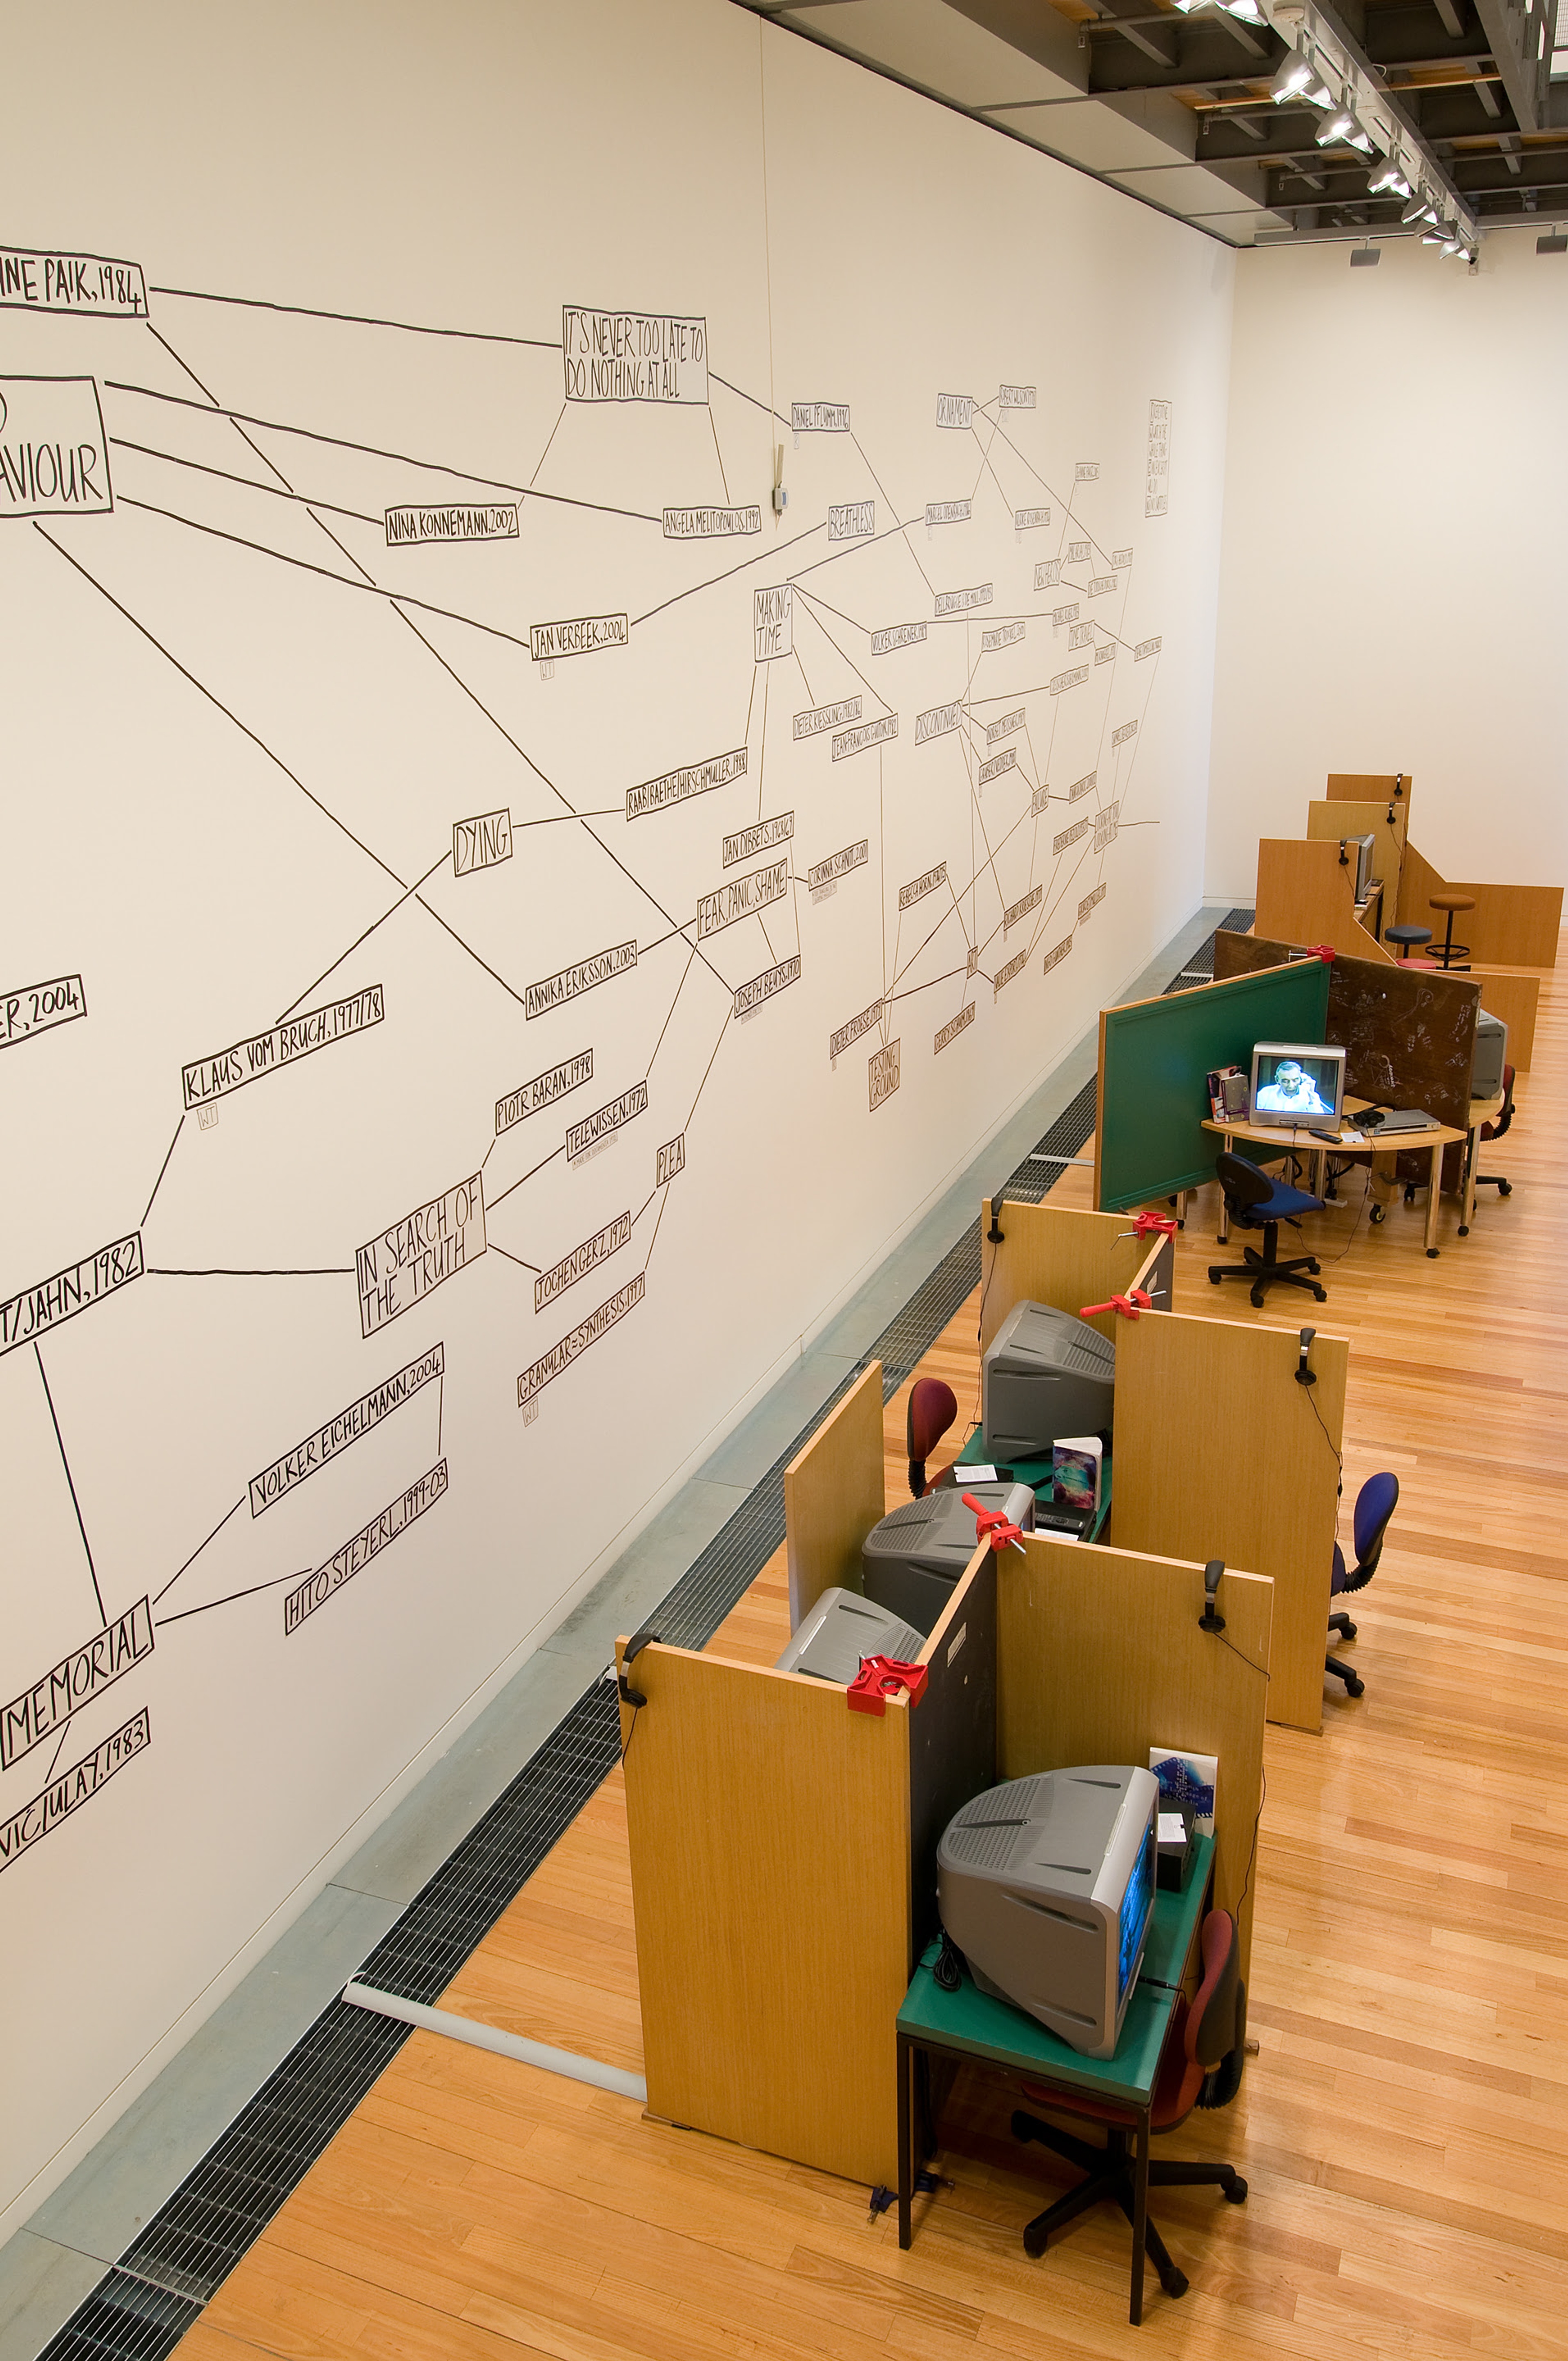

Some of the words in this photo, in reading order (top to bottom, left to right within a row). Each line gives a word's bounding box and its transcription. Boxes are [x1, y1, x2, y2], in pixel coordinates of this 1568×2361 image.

[0, 257, 39, 301] NE
[565, 312, 589, 354] IT'S
[592, 315, 635, 357] NEVER
[636, 320, 659, 356] TOO
[663, 319, 687, 362] LATE
[690, 327, 703, 362] TO
[567, 358, 586, 397] DO
[591, 358, 644, 398] NOTHING
[648, 360, 659, 398] AT
[662, 362, 679, 399] ALL
[389, 512, 417, 540] NINA
[665, 511, 695, 534] ANGELA
[830, 503, 873, 537] BREATHLESS
[756, 587, 791, 626] MAKING
[535, 627, 554, 658] JAN
[757, 623, 782, 655] TIME
[915, 702, 962, 742] DISCONTINUED
[457, 816, 507, 872] DYING
[724, 837, 738, 863] JAN
[528, 976, 564, 1014] ANNIKA
[736, 980, 762, 1012] JOSEPH
[186, 1050, 243, 1101] KLAUS
[247, 1035, 274, 1071] VOM
[870, 1045, 895, 1083] TESTING
[870, 1064, 899, 1106] GROUND
[497, 1088, 529, 1128] PIOTR
[658, 1139, 682, 1183] PLEA
[360, 1244, 378, 1293] IN
[385, 1197, 447, 1273] SEARCH
[456, 1177, 477, 1227] OF
[363, 1274, 401, 1328] THE
[408, 1227, 465, 1295] TRUTH
[537, 1254, 577, 1306] JOCHEN
[256, 1441, 318, 1503] VOLKER
[290, 1571, 329, 1625] HITO
[7, 1612, 148, 1758] MEMORIAL
